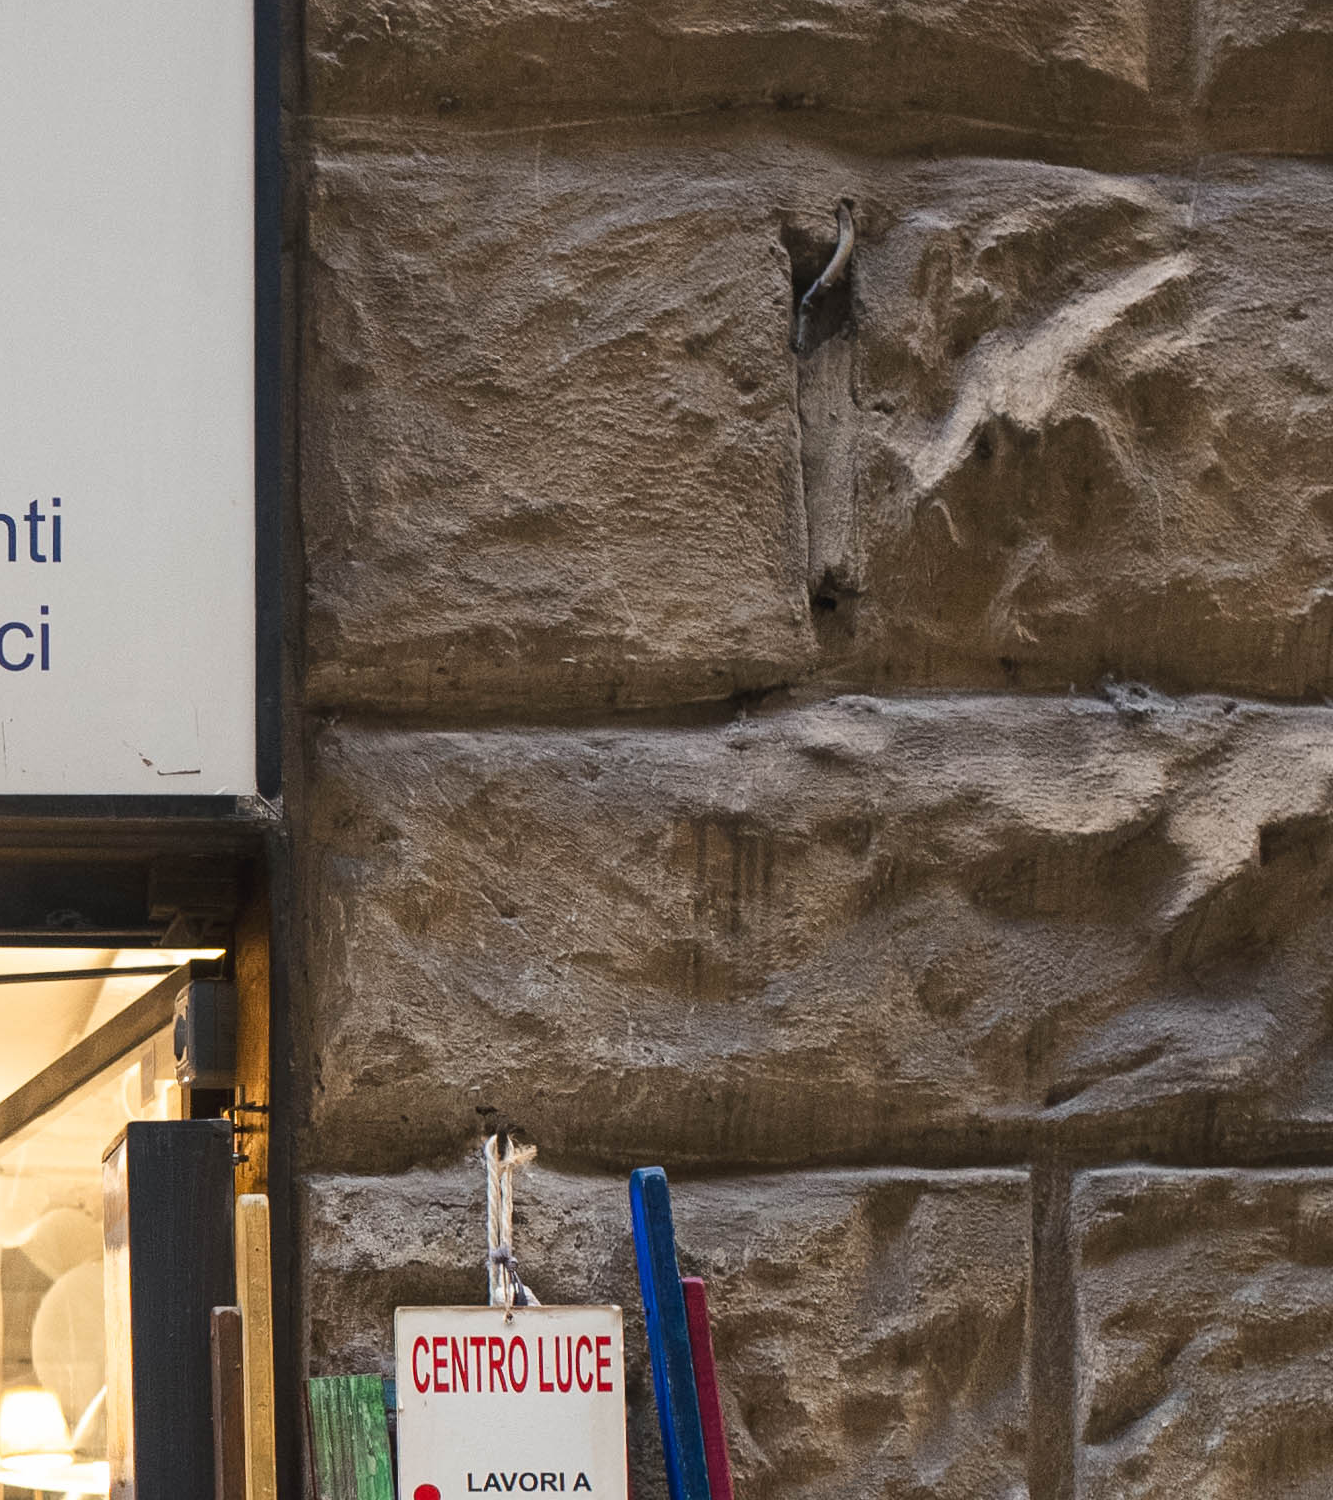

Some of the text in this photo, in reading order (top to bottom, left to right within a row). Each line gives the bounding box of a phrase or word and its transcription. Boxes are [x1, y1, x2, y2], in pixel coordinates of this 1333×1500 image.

[411, 1334, 615, 1395] CENTRO LUCE
[466, 1472, 593, 1493] LAVORI A
